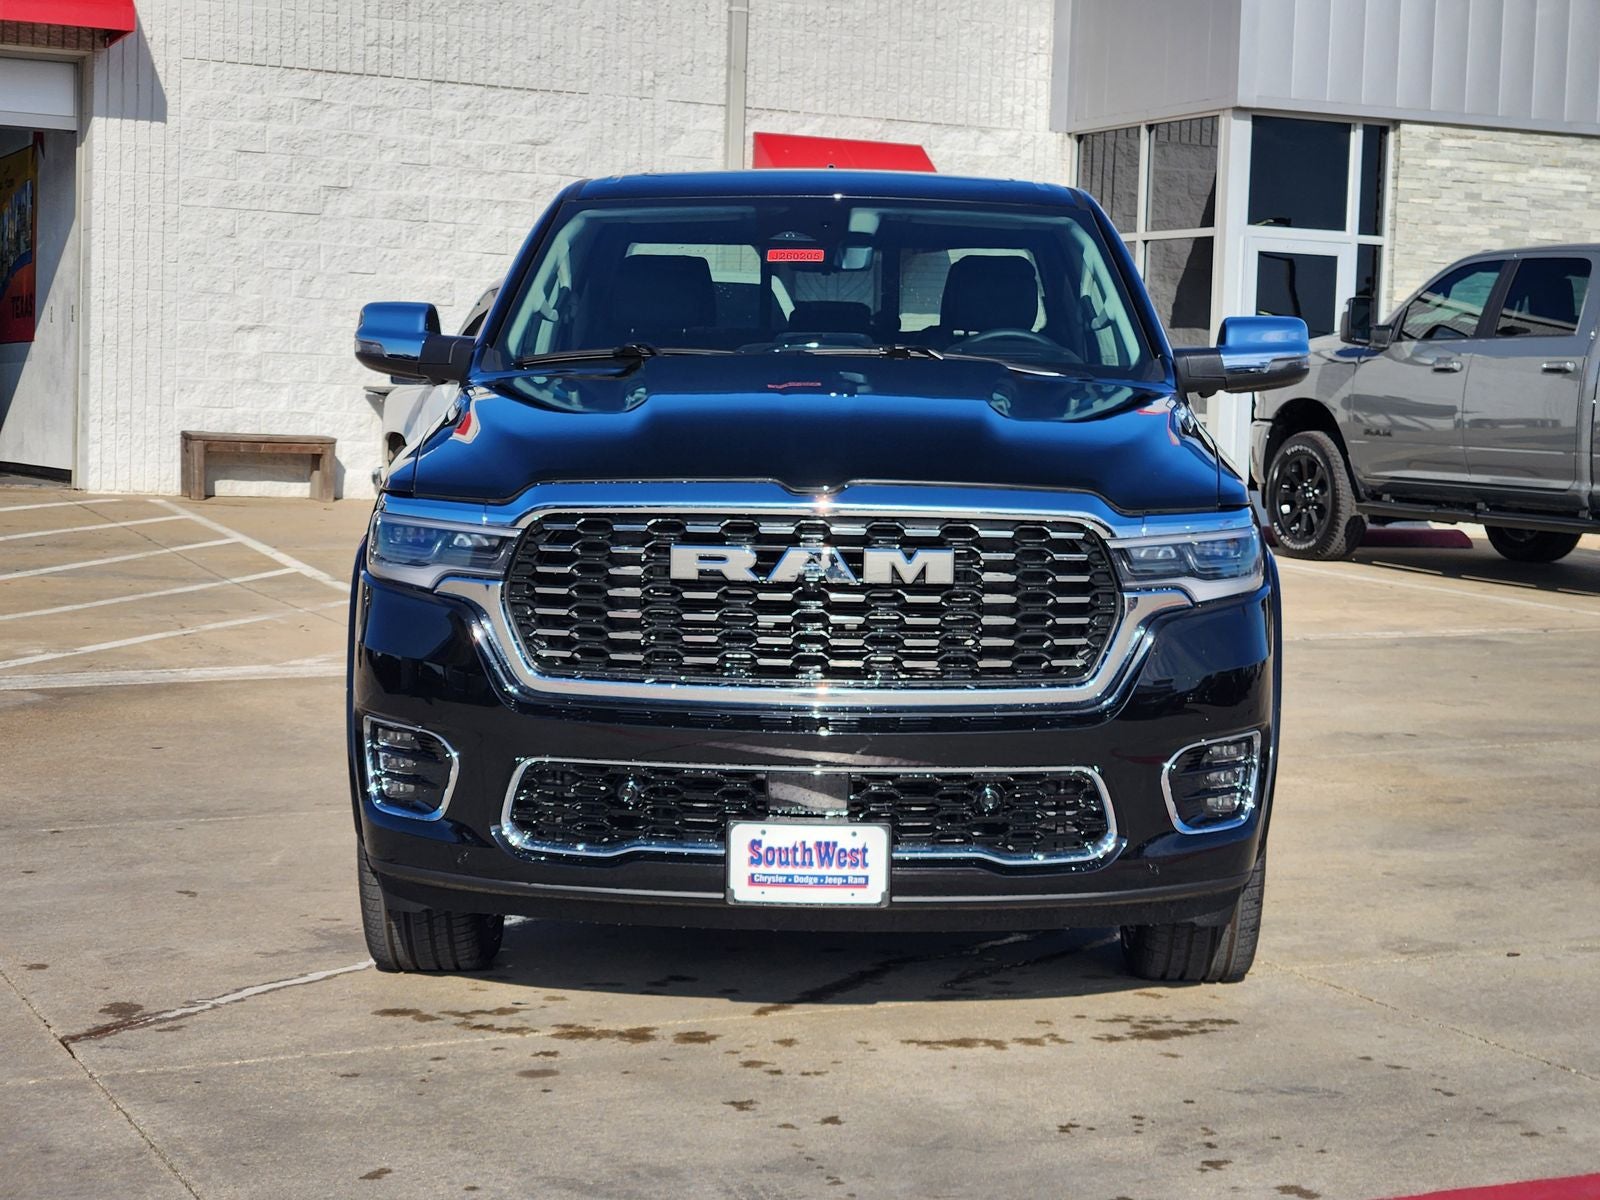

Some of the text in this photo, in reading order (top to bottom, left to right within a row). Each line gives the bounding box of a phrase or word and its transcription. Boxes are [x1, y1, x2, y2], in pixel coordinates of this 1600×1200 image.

[670, 544, 954, 585] RAM
[749, 838, 869, 869] SouthWest
[753, 873, 866, 886] Chrysler Dodge Jeep Ram
